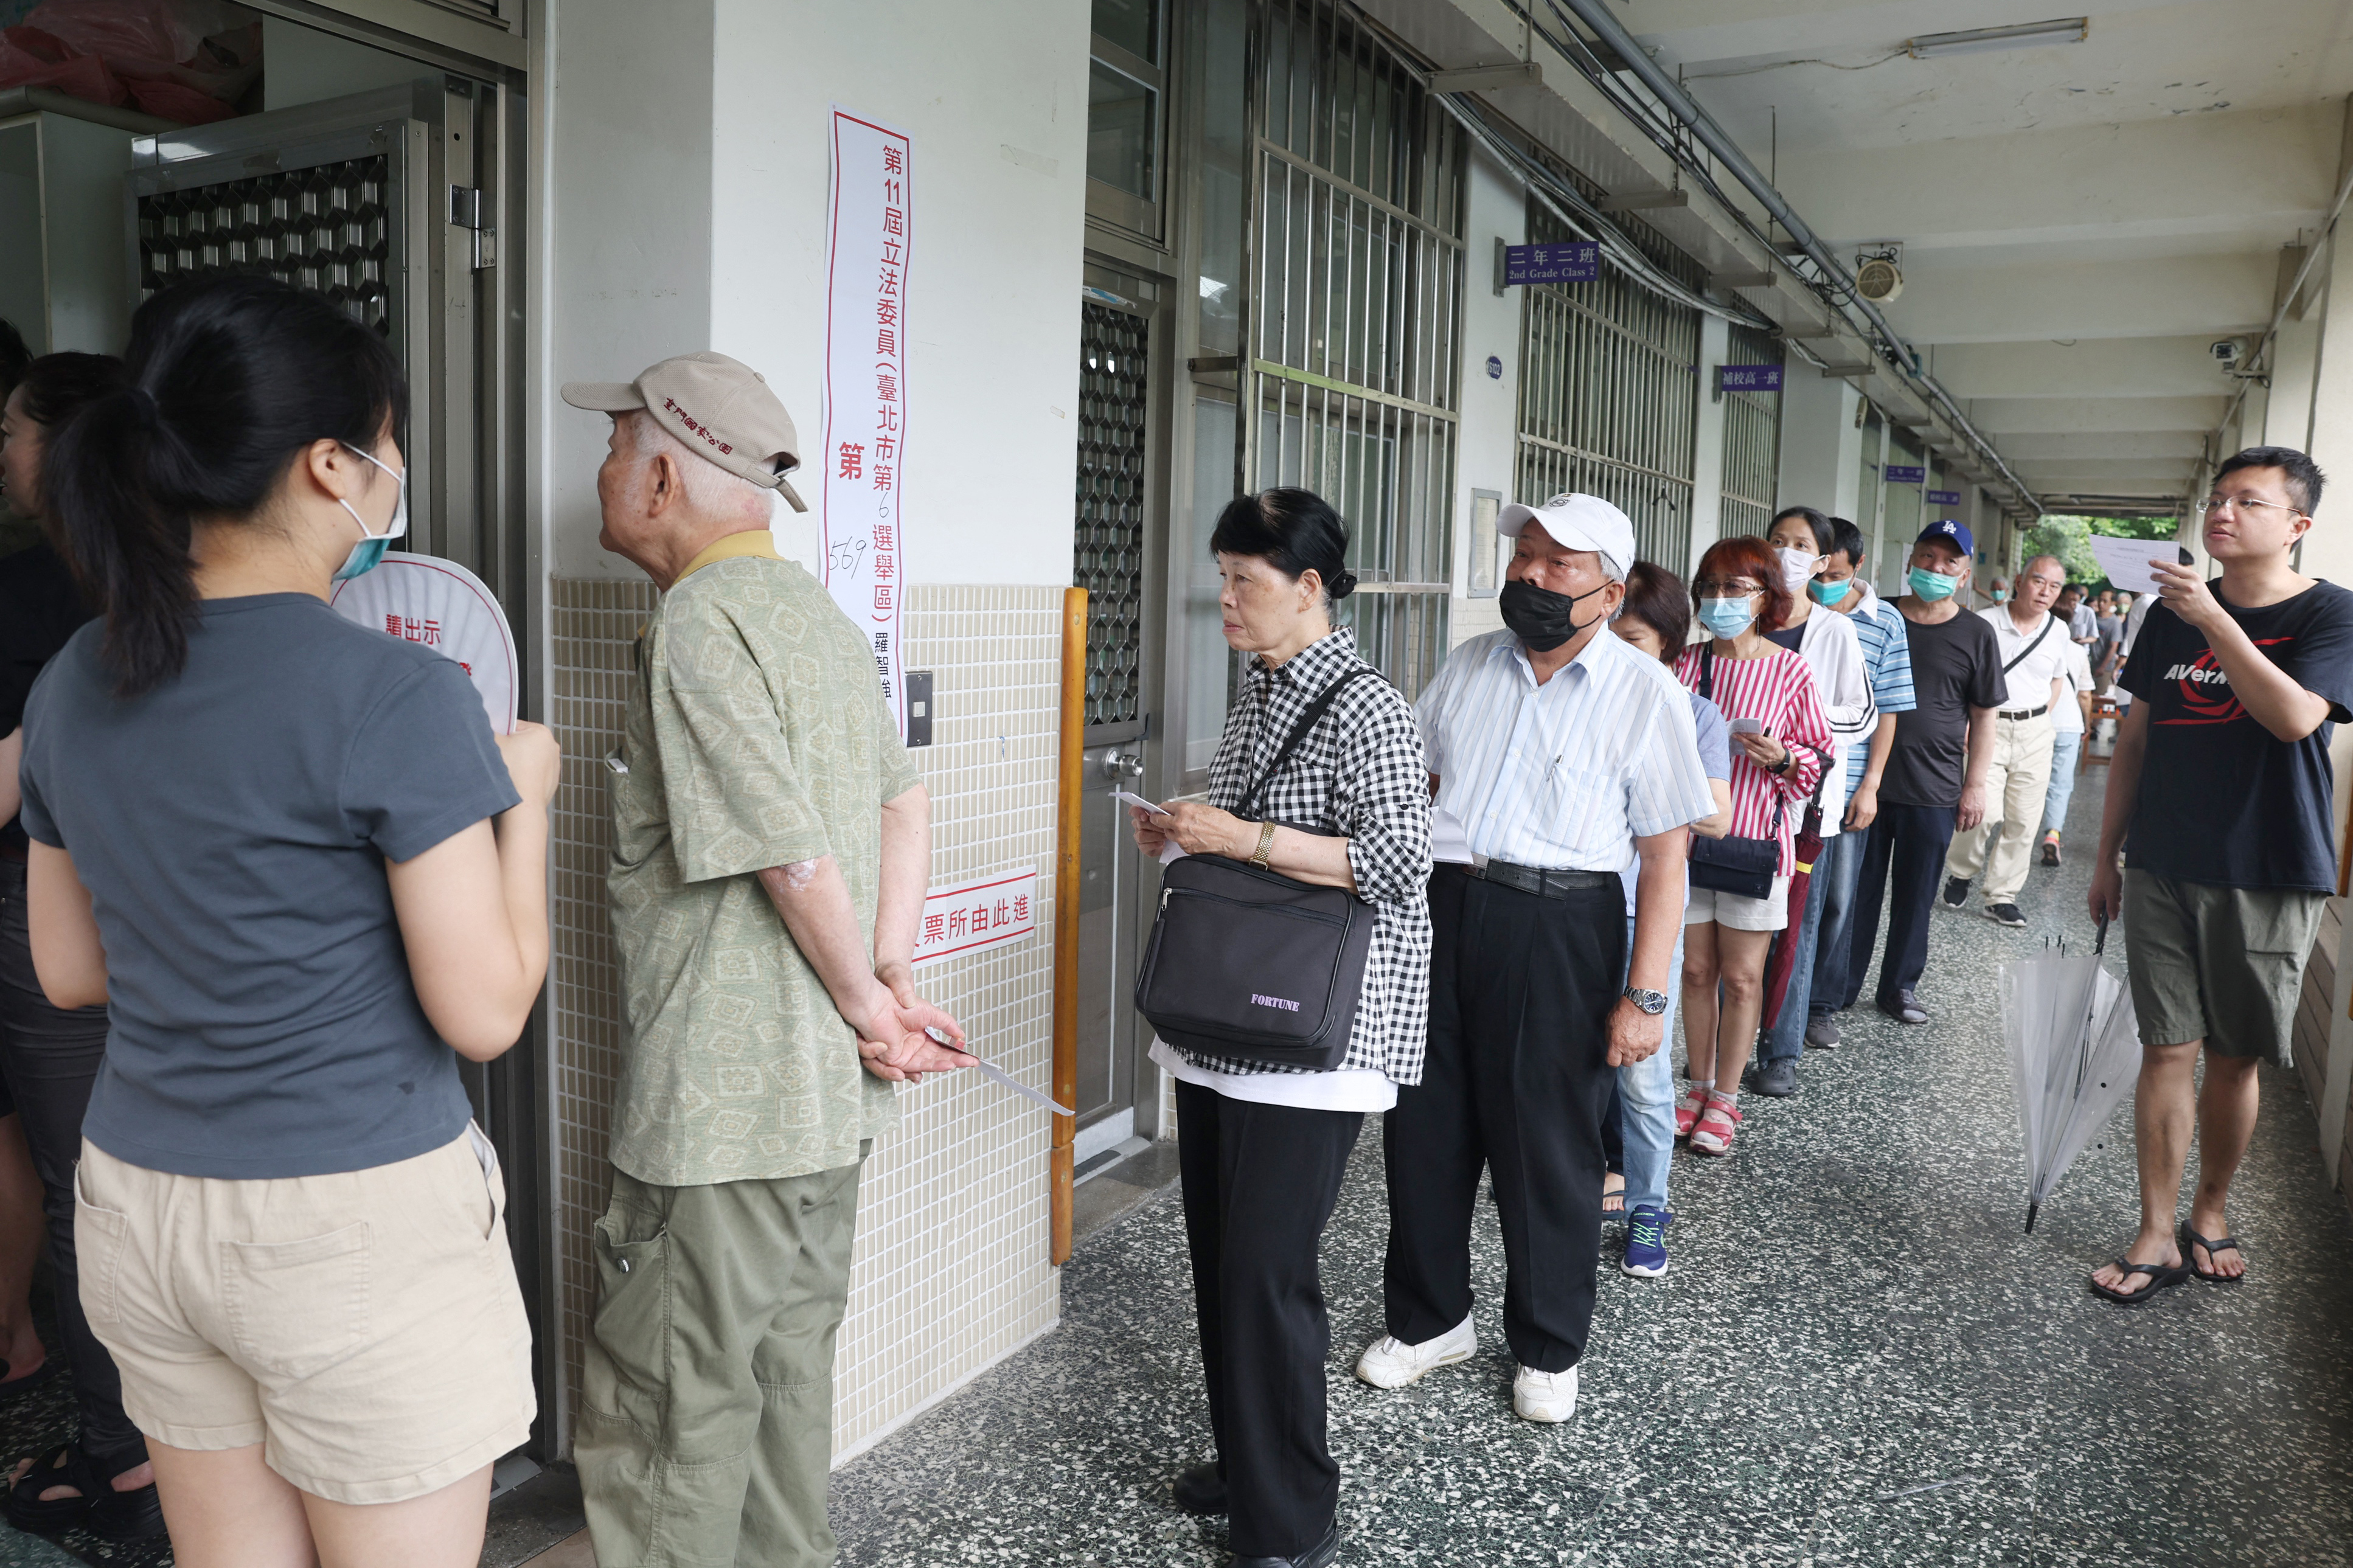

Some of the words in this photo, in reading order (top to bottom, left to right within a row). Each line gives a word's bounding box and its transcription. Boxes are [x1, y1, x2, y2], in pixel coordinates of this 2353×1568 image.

[1510, 248, 1595, 266] 二年二班
[1509, 269, 1526, 279] 2nd
[1529, 268, 1558, 279] Grade
[1562, 267, 1586, 277] Class
[1589, 266, 1595, 276] 2
[1723, 371, 1779, 385] 補校高一班
[838, 442, 865, 480] 第
[1942, 520, 1957, 534] LA
[829, 536, 867, 580] 569
[386, 614, 440, 645] 請出示
[915, 893, 1029, 947] 票所由此進
[1251, 993, 1300, 1012] FORTUNE
